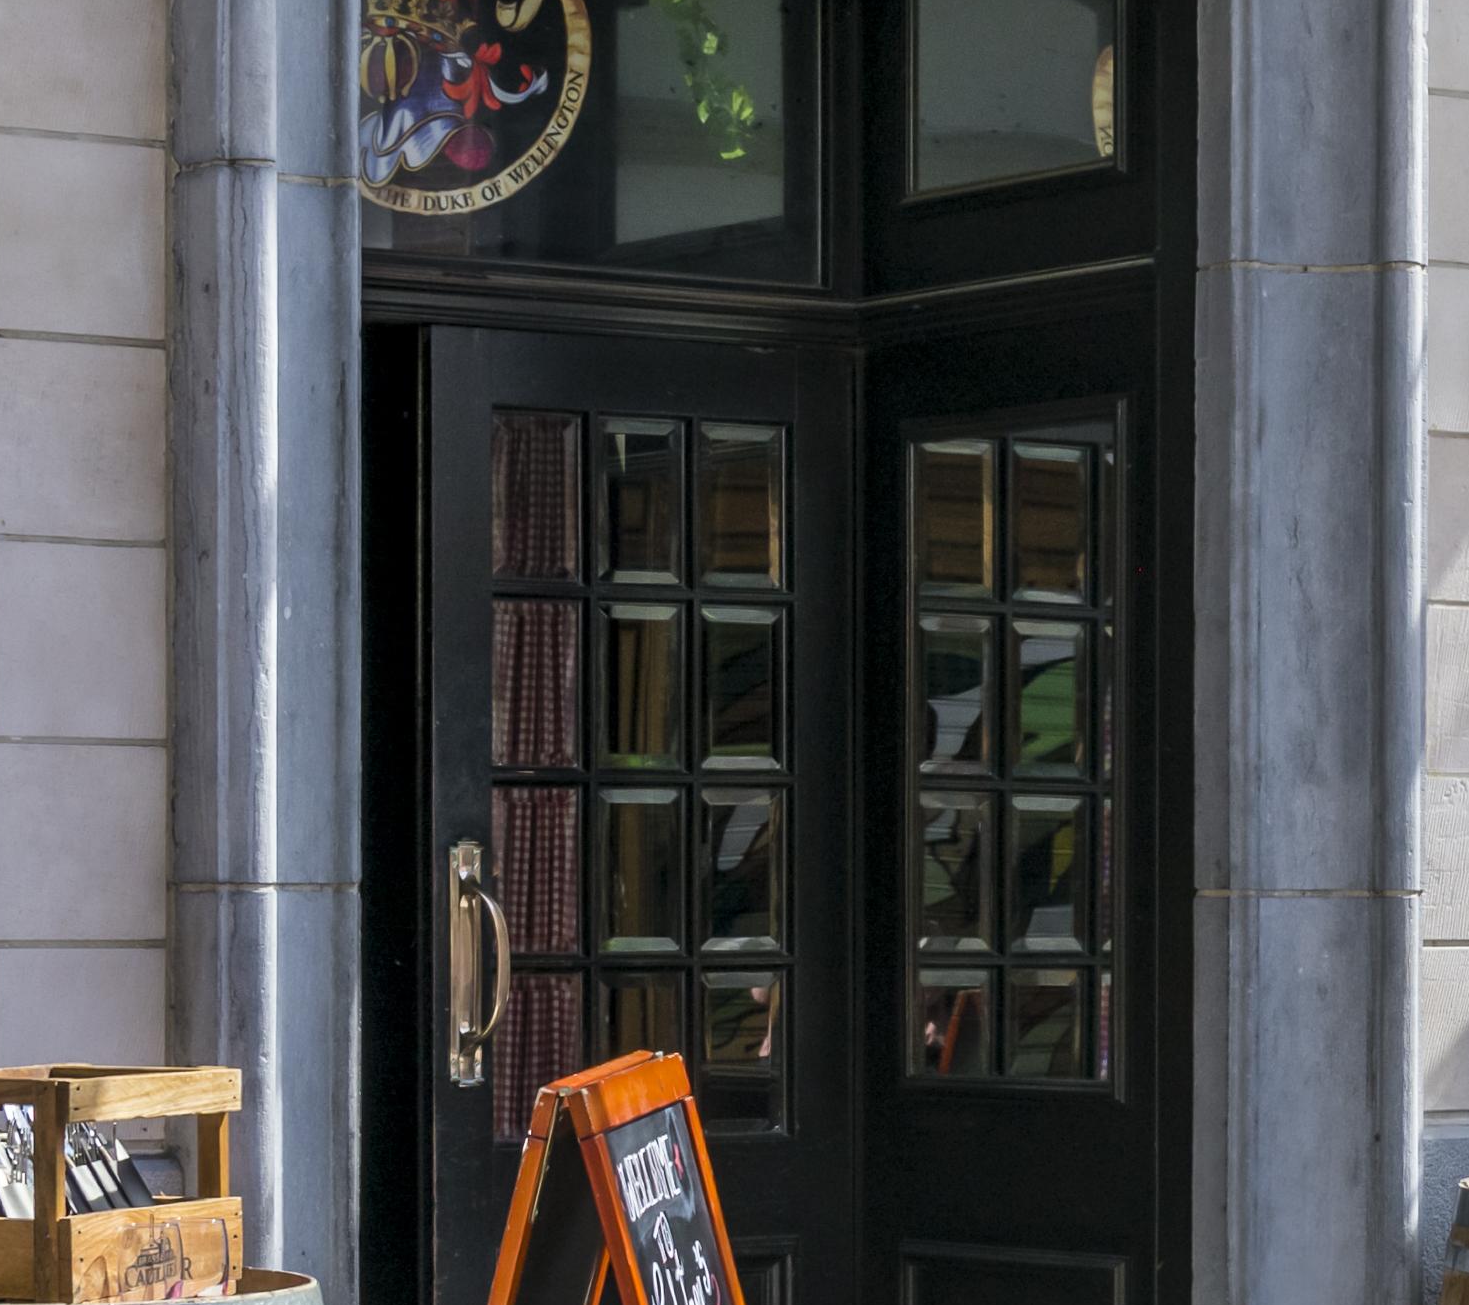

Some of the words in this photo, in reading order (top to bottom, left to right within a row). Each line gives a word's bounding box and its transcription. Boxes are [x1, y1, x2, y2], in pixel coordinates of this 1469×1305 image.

[422, 190, 476, 212] DUKE
[481, 179, 504, 202] OF
[506, 69, 585, 186] WELLINGTON
[616, 1133, 682, 1222] WELCOME
[653, 1210, 676, 1265] TO
